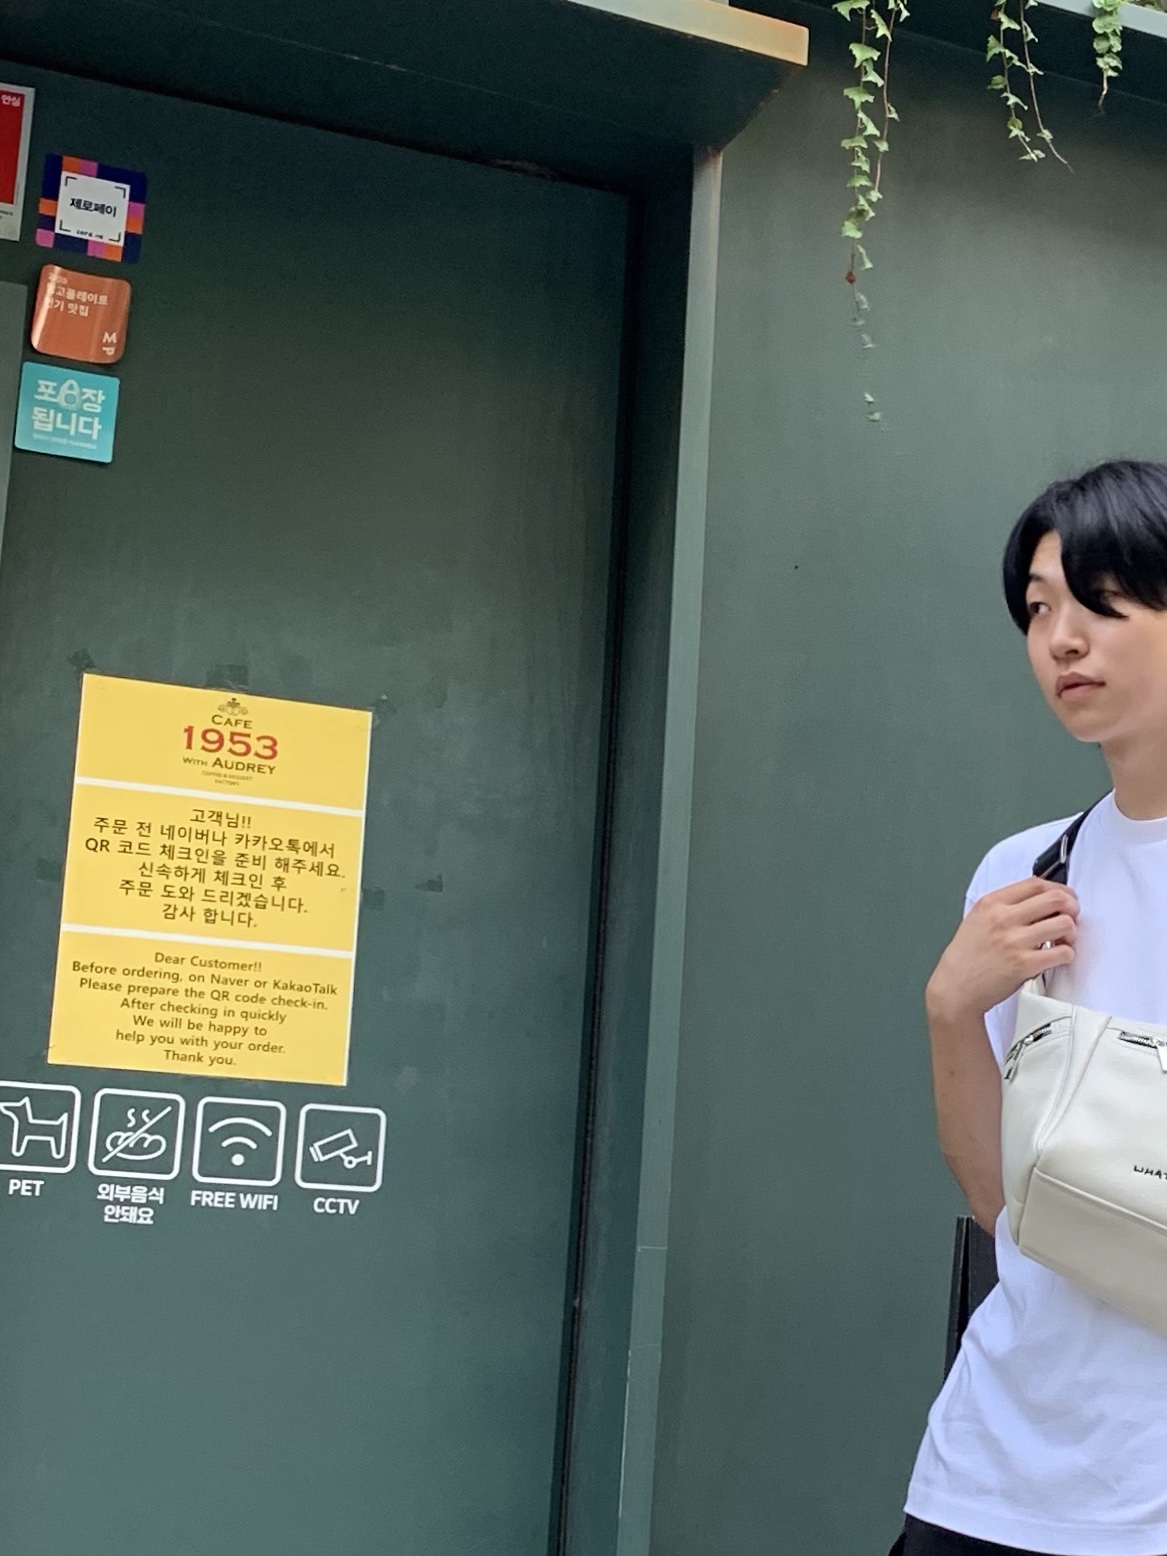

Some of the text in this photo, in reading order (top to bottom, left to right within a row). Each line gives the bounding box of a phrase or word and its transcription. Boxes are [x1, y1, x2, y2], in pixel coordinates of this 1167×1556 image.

[69, 198, 117, 217] 제로페이
[46, 283, 109, 305] 고플레이트
[68, 303, 89, 317] 맛집
[32, 407, 102, 440] 됩니다
[212, 714, 252, 729] CAFE
[184, 725, 278, 760] 1953
[212, 757, 276, 774] AUDREY
[190, 809, 252, 829] 고객님!!
[94, 817, 335, 858] 주문 전 네이버나 카카오톡에서
[85, 838, 345, 878] QR 코드 체크인을 준비 해주세요.
[139, 862, 287, 891] 신속하게 체크인 후
[119, 879, 308, 913] 주문 도와 드리겠습니다.
[162, 904, 257, 927] 감사 합니다.
[155, 952, 262, 972] Dear Customer!!
[72, 961, 338, 996] Before ordering, on Naver or KakaoTalk
[80, 978, 328, 1010] Please prepare the QR code check-in.
[120, 997, 287, 1024] After checking in quickly
[133, 1015, 267, 1037] We will be happy to
[116, 1029, 286, 1054] help you with your order.
[164, 1050, 236, 1067] Thank you.
[8, 1179, 44, 1196] PET
[97, 1183, 164, 1204] 외부음식
[191, 1190, 236, 1208] FREE
[313, 1198, 359, 1214] CCTV
[103, 1206, 154, 1225] 안돼요
